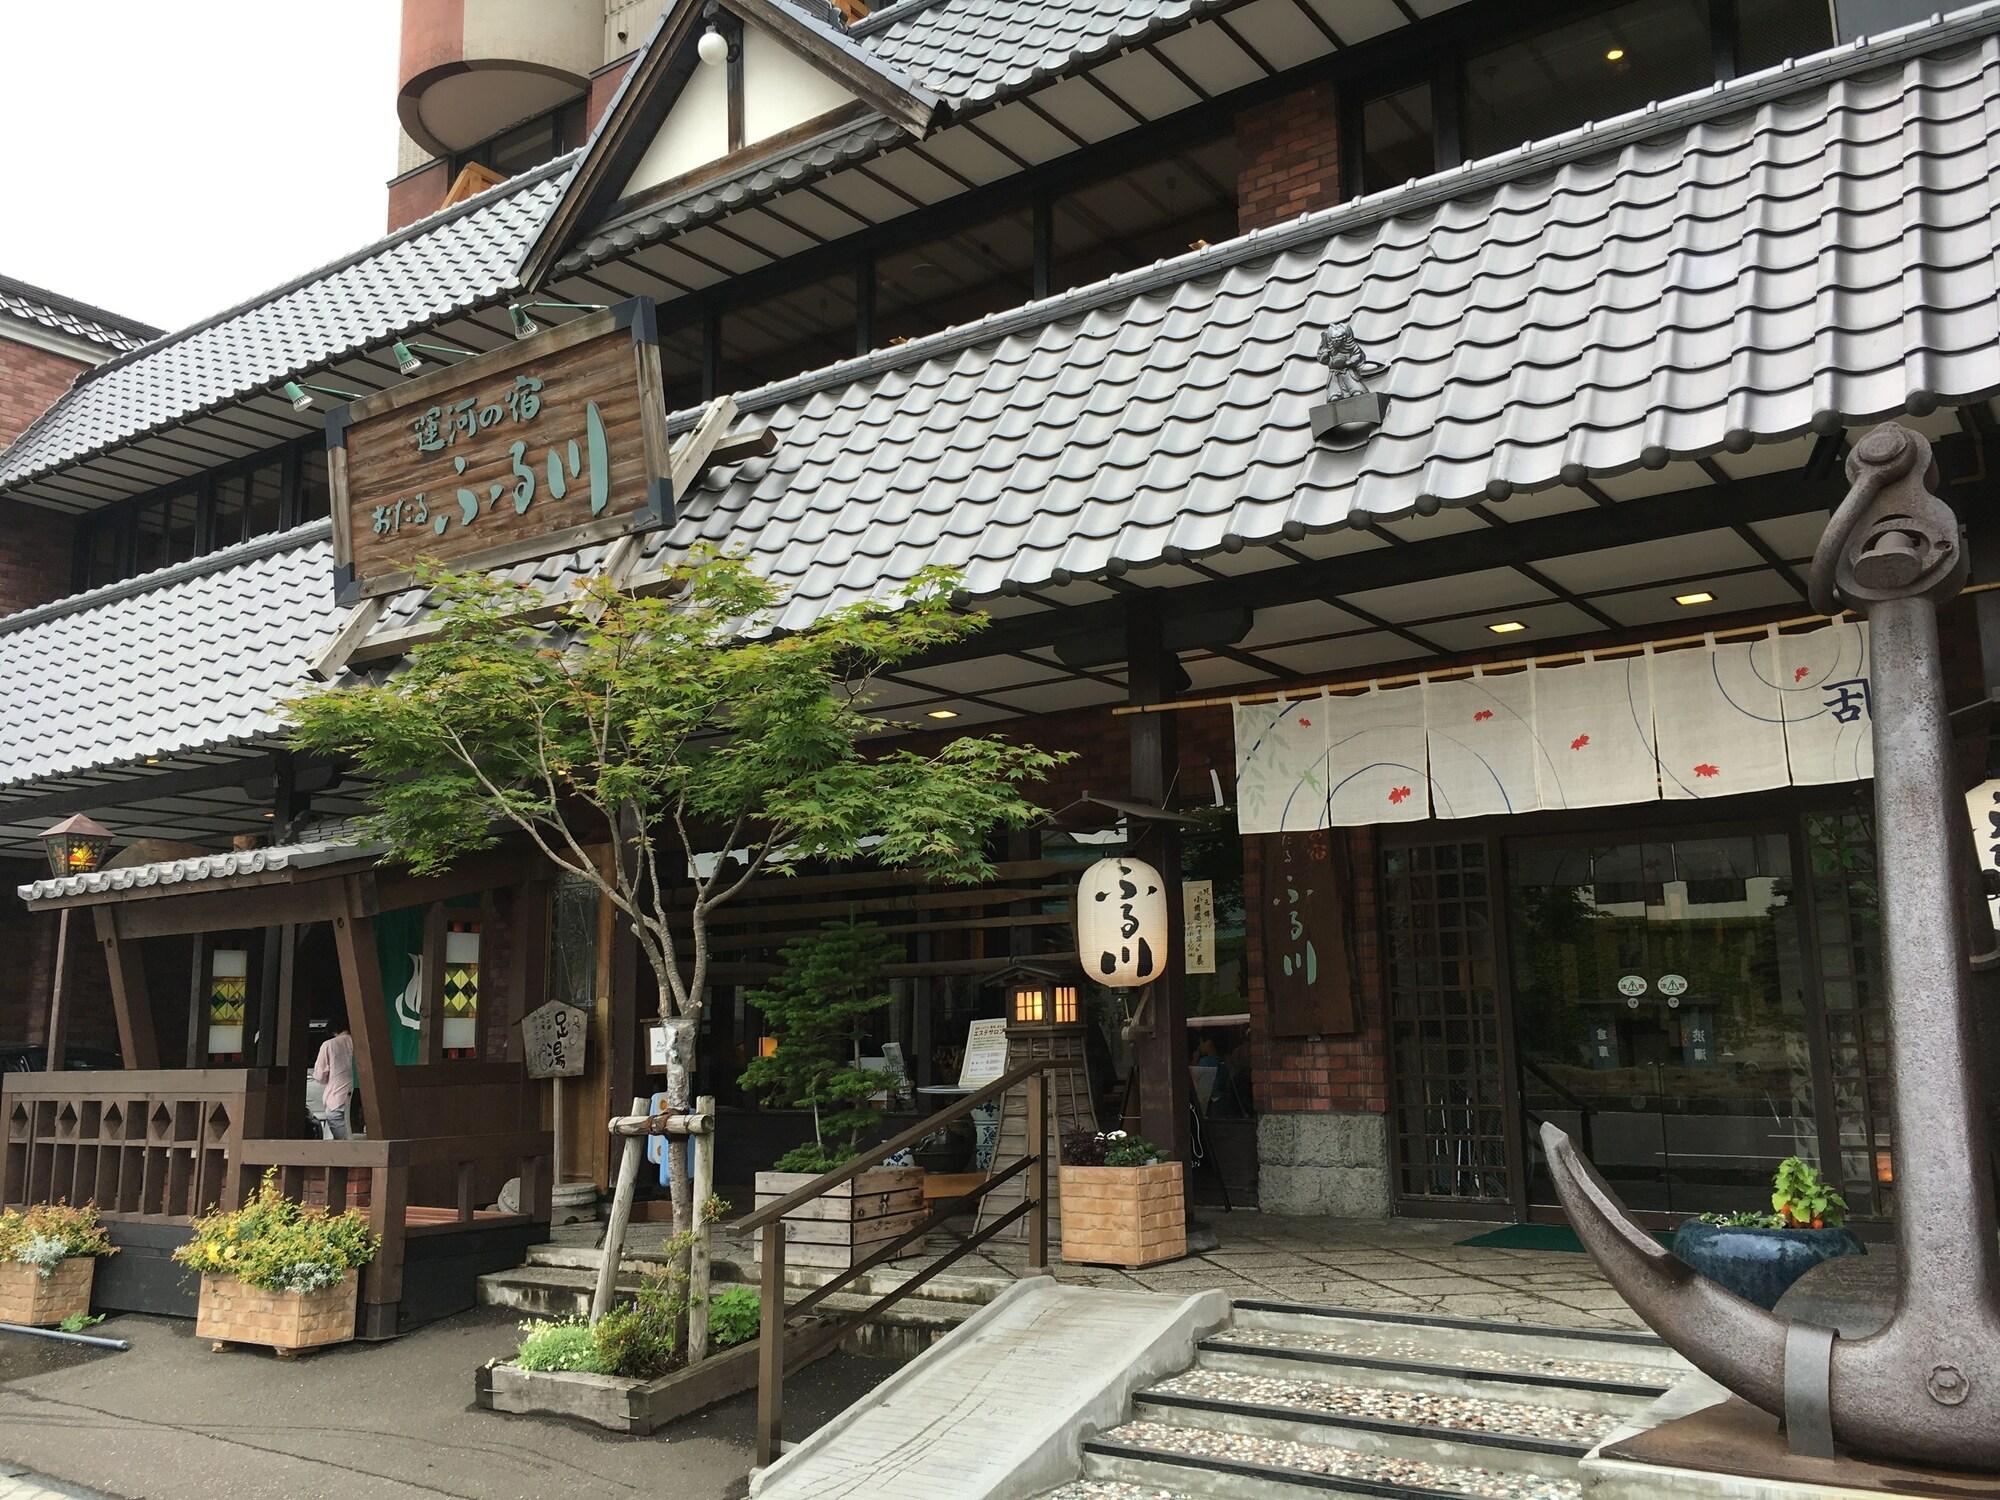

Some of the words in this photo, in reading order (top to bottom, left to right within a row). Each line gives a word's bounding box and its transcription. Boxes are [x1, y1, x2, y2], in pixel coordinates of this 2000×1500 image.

[371, 492, 428, 535] おたる
[433, 399, 610, 519] ふる川
[414, 375, 545, 452] 運河の宿
[1095, 865, 1158, 978] ふる川
[1272, 874, 1318, 986] ふる川
[547, 1010, 569, 1070] 足湯
